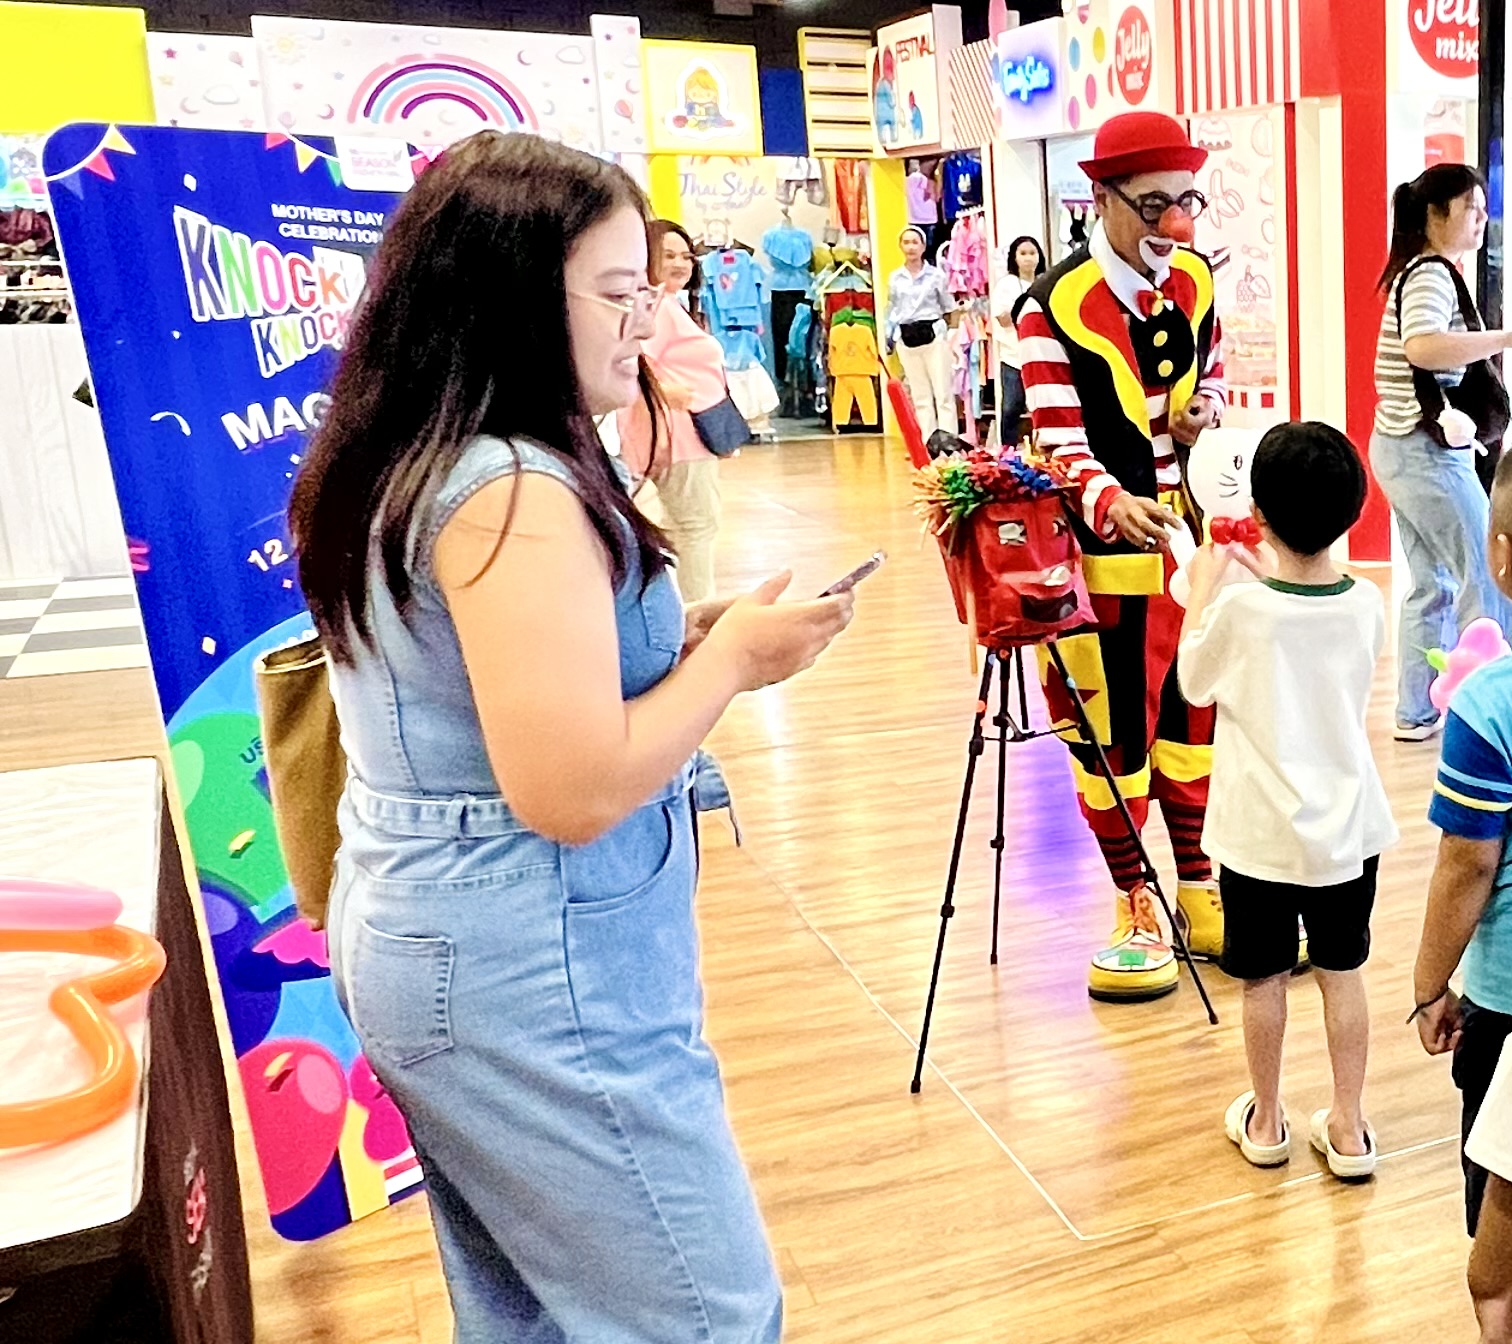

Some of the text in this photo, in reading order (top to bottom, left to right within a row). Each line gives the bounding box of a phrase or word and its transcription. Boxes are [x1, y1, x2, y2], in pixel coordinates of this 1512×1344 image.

[1116, 18, 1150, 72] Jelly
[677, 171, 767, 209] Thai Style
[271, 204, 384, 226] MOTHER'S DAY
[175, 209, 350, 320] KNOCK
[247, 538, 288, 572] 12
